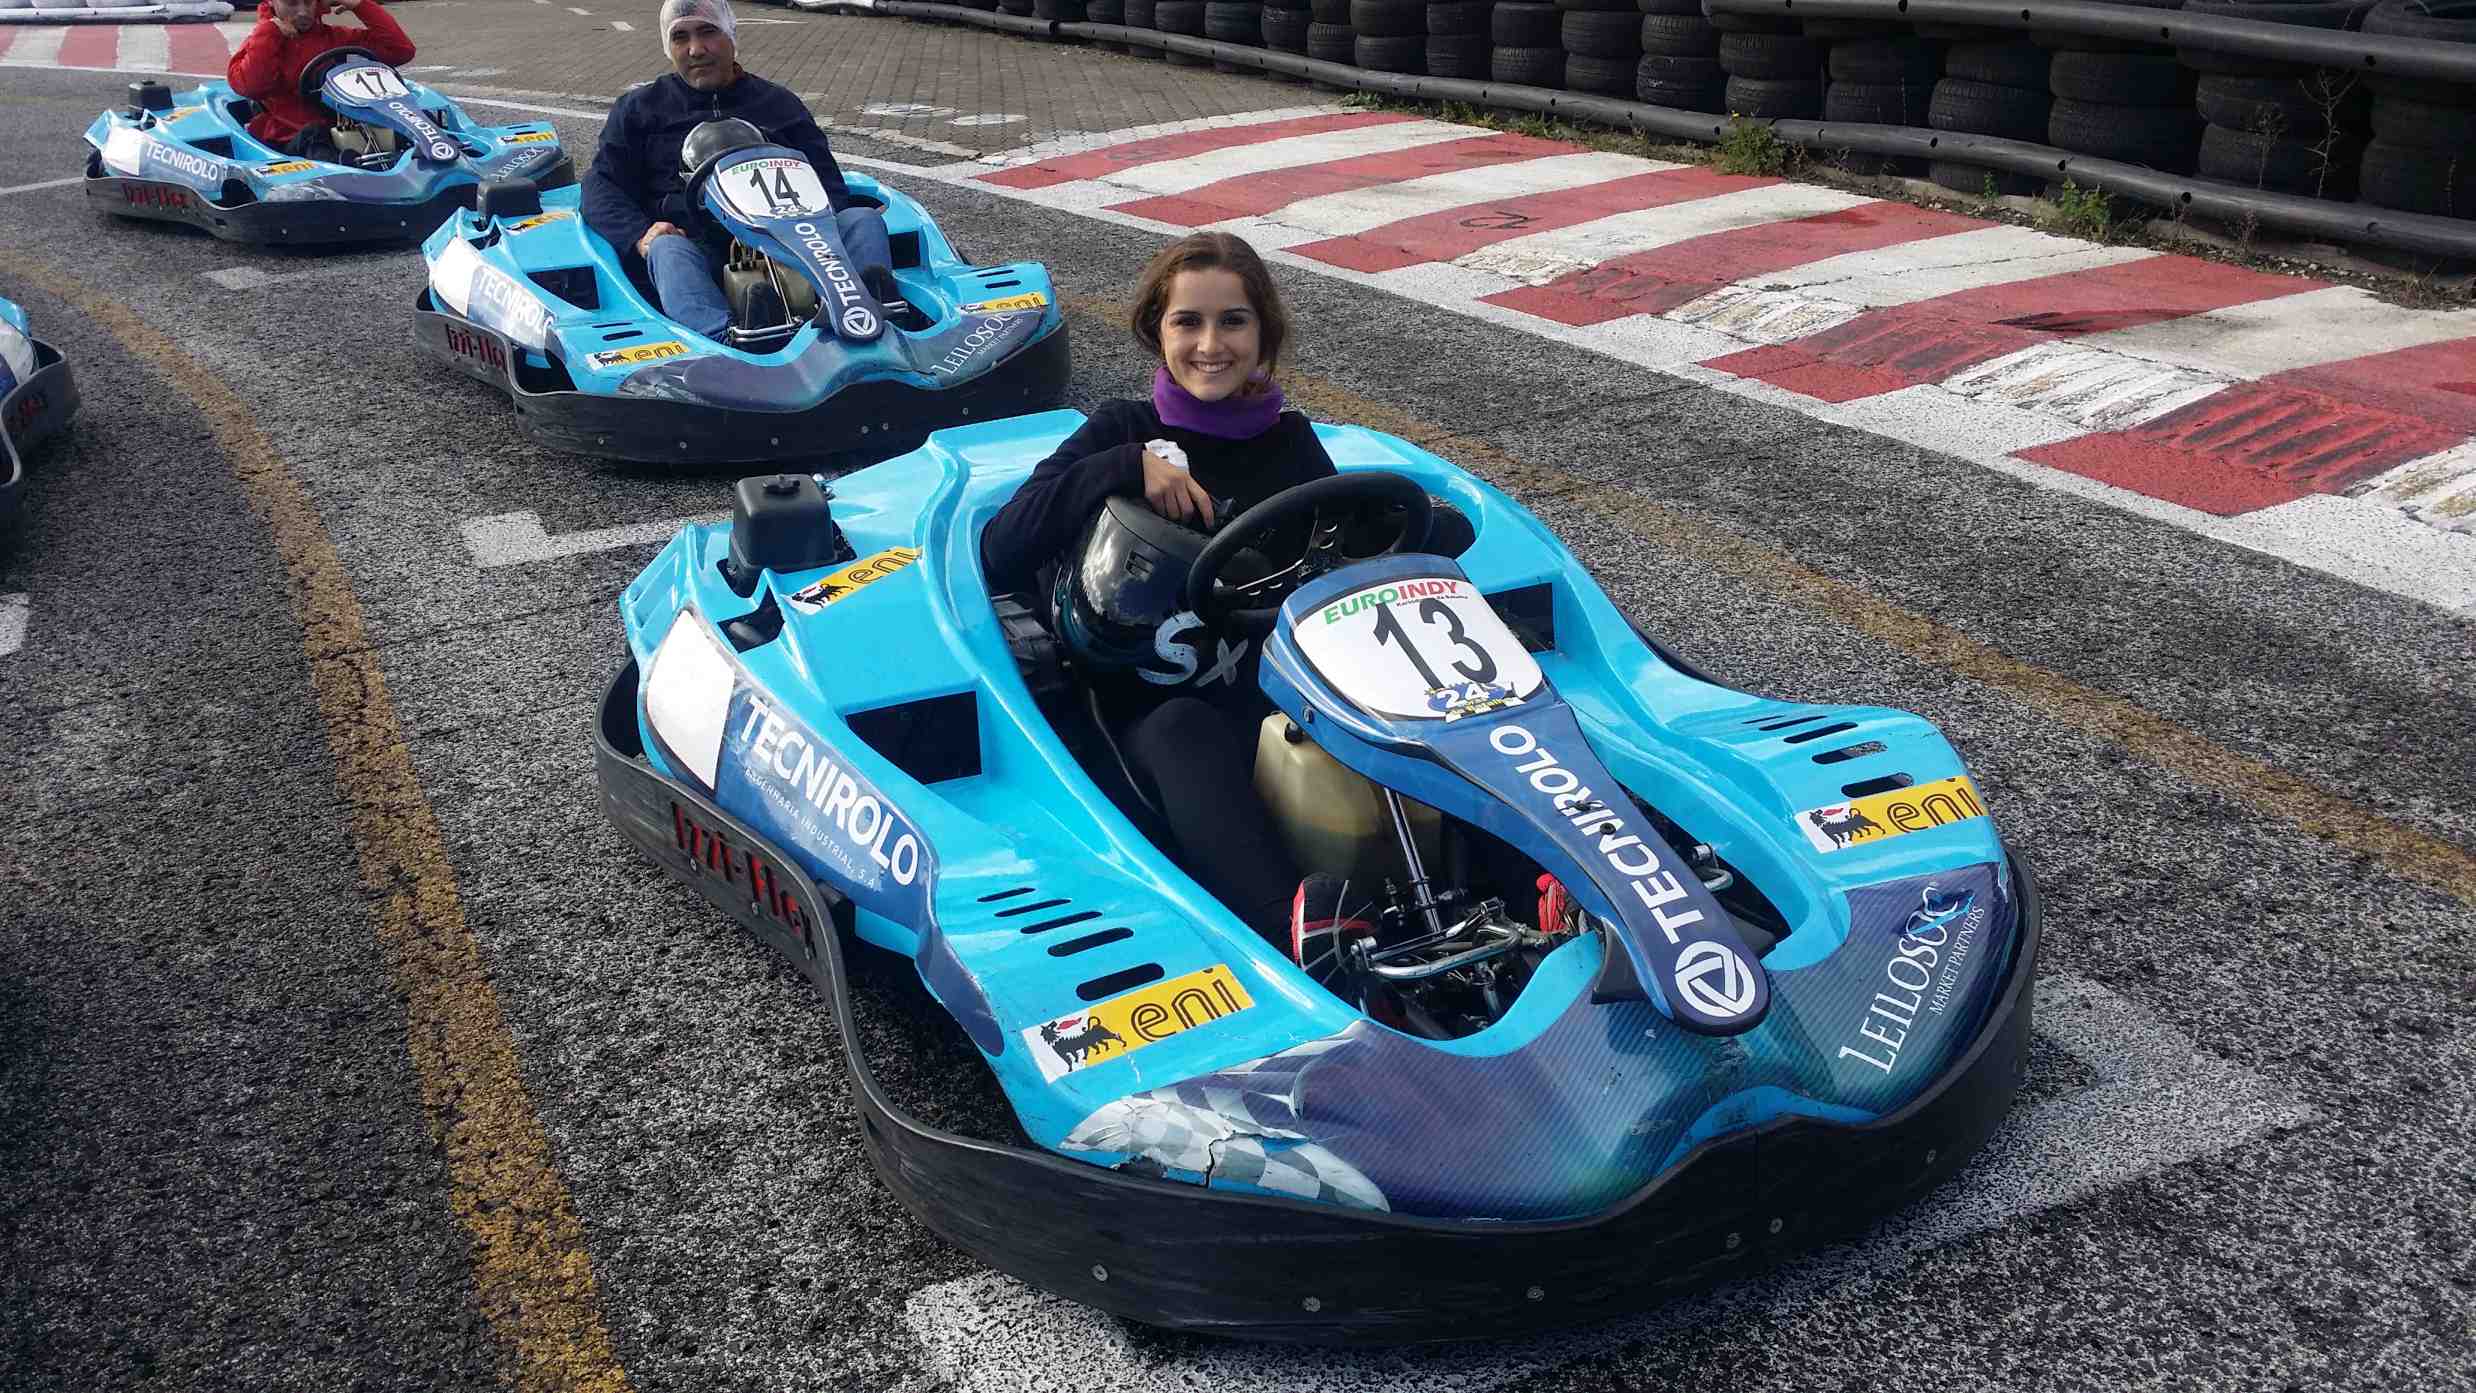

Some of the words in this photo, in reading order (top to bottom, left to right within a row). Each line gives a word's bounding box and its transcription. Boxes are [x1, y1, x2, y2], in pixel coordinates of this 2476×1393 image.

[354, 71, 389, 98] 17
[146, 143, 218, 181] TECNIROLO
[731, 160, 801, 176] EUROINDY
[750, 167, 801, 208] 14
[795, 222, 861, 307] TECNIROLO
[634, 341, 685, 361] eni
[848, 549, 919, 585] eni
[1323, 581, 1457, 625] EUROINDY
[1373, 597, 1498, 690] 13
[740, 695, 919, 886] TECNIROLO
[1887, 777, 1984, 833] eni
[1489, 725, 1705, 945] TECNIROLO
[1838, 886, 1959, 1075] LEILOSOC
[1928, 963, 1959, 1016] MARKET
[1948, 905, 1985, 967] PARTNERS
[1130, 967, 1243, 1043] eni
